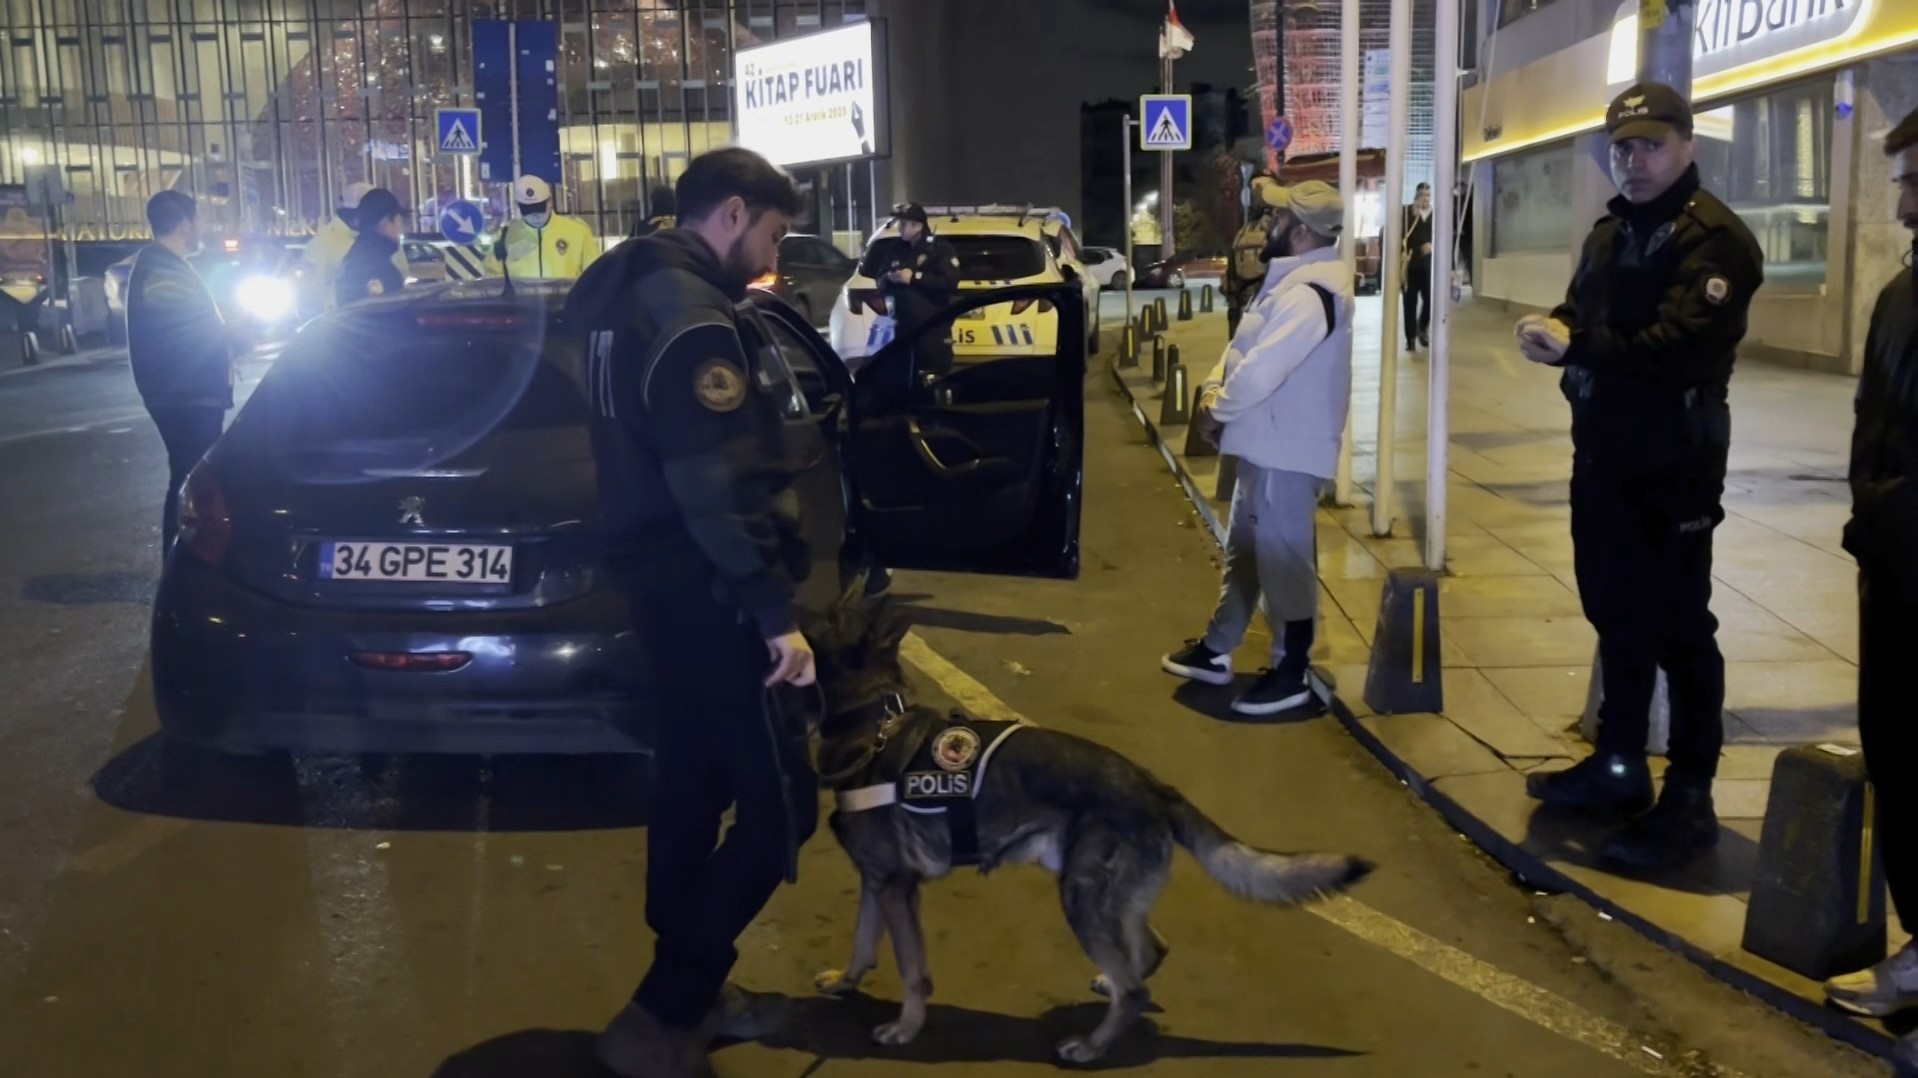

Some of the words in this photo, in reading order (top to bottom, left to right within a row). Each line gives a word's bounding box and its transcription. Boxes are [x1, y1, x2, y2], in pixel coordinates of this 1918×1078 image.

[745, 67, 799, 109] KİTAP
[804, 58, 863, 99] FUARI
[335, 545, 371, 576] 34
[380, 546, 450, 578] GPE
[456, 548, 508, 580] 314
